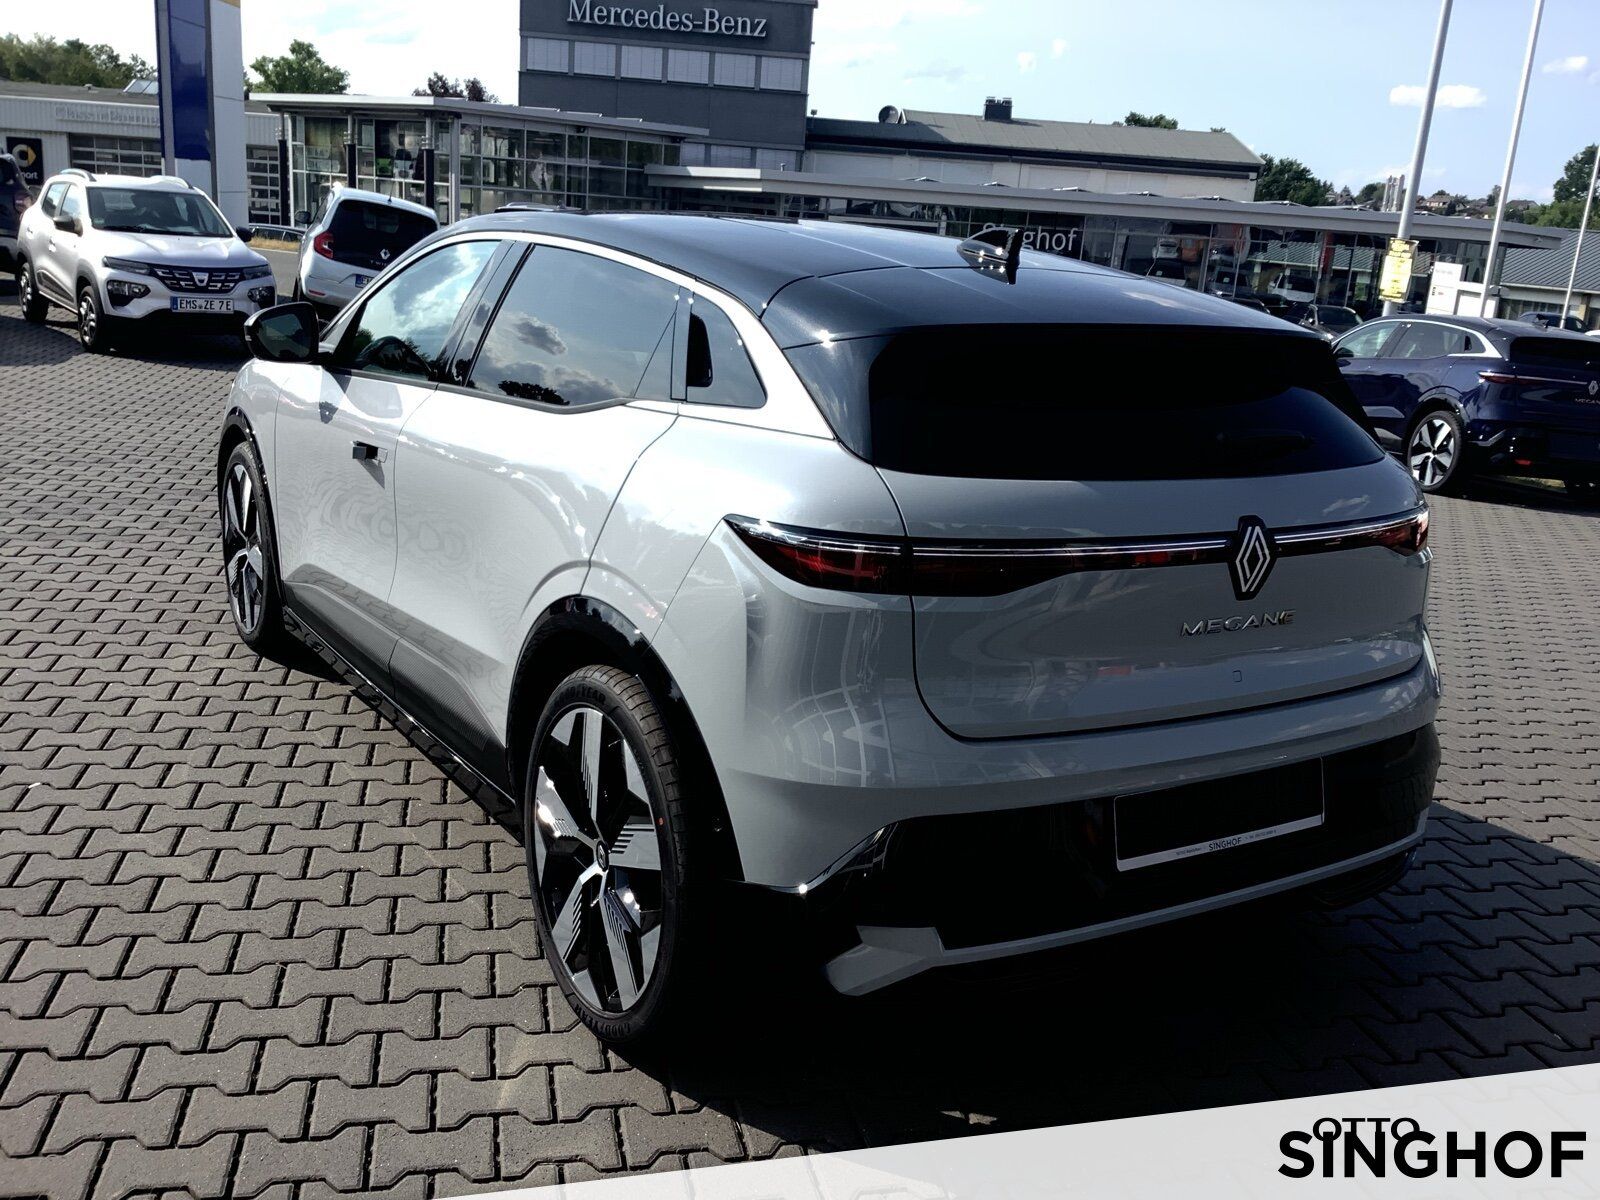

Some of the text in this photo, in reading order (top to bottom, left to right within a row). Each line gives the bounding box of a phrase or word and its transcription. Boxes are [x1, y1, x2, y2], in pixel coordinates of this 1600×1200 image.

[566, 0, 767, 38] Mercedes-Benz
[983, 222, 1079, 252] ghof
[179, 299, 197, 310] EMS
[204, 299, 215, 310] ZE
[1180, 608, 1297, 637] MEGANE
[1208, 836, 1242, 851] SINGHOF
